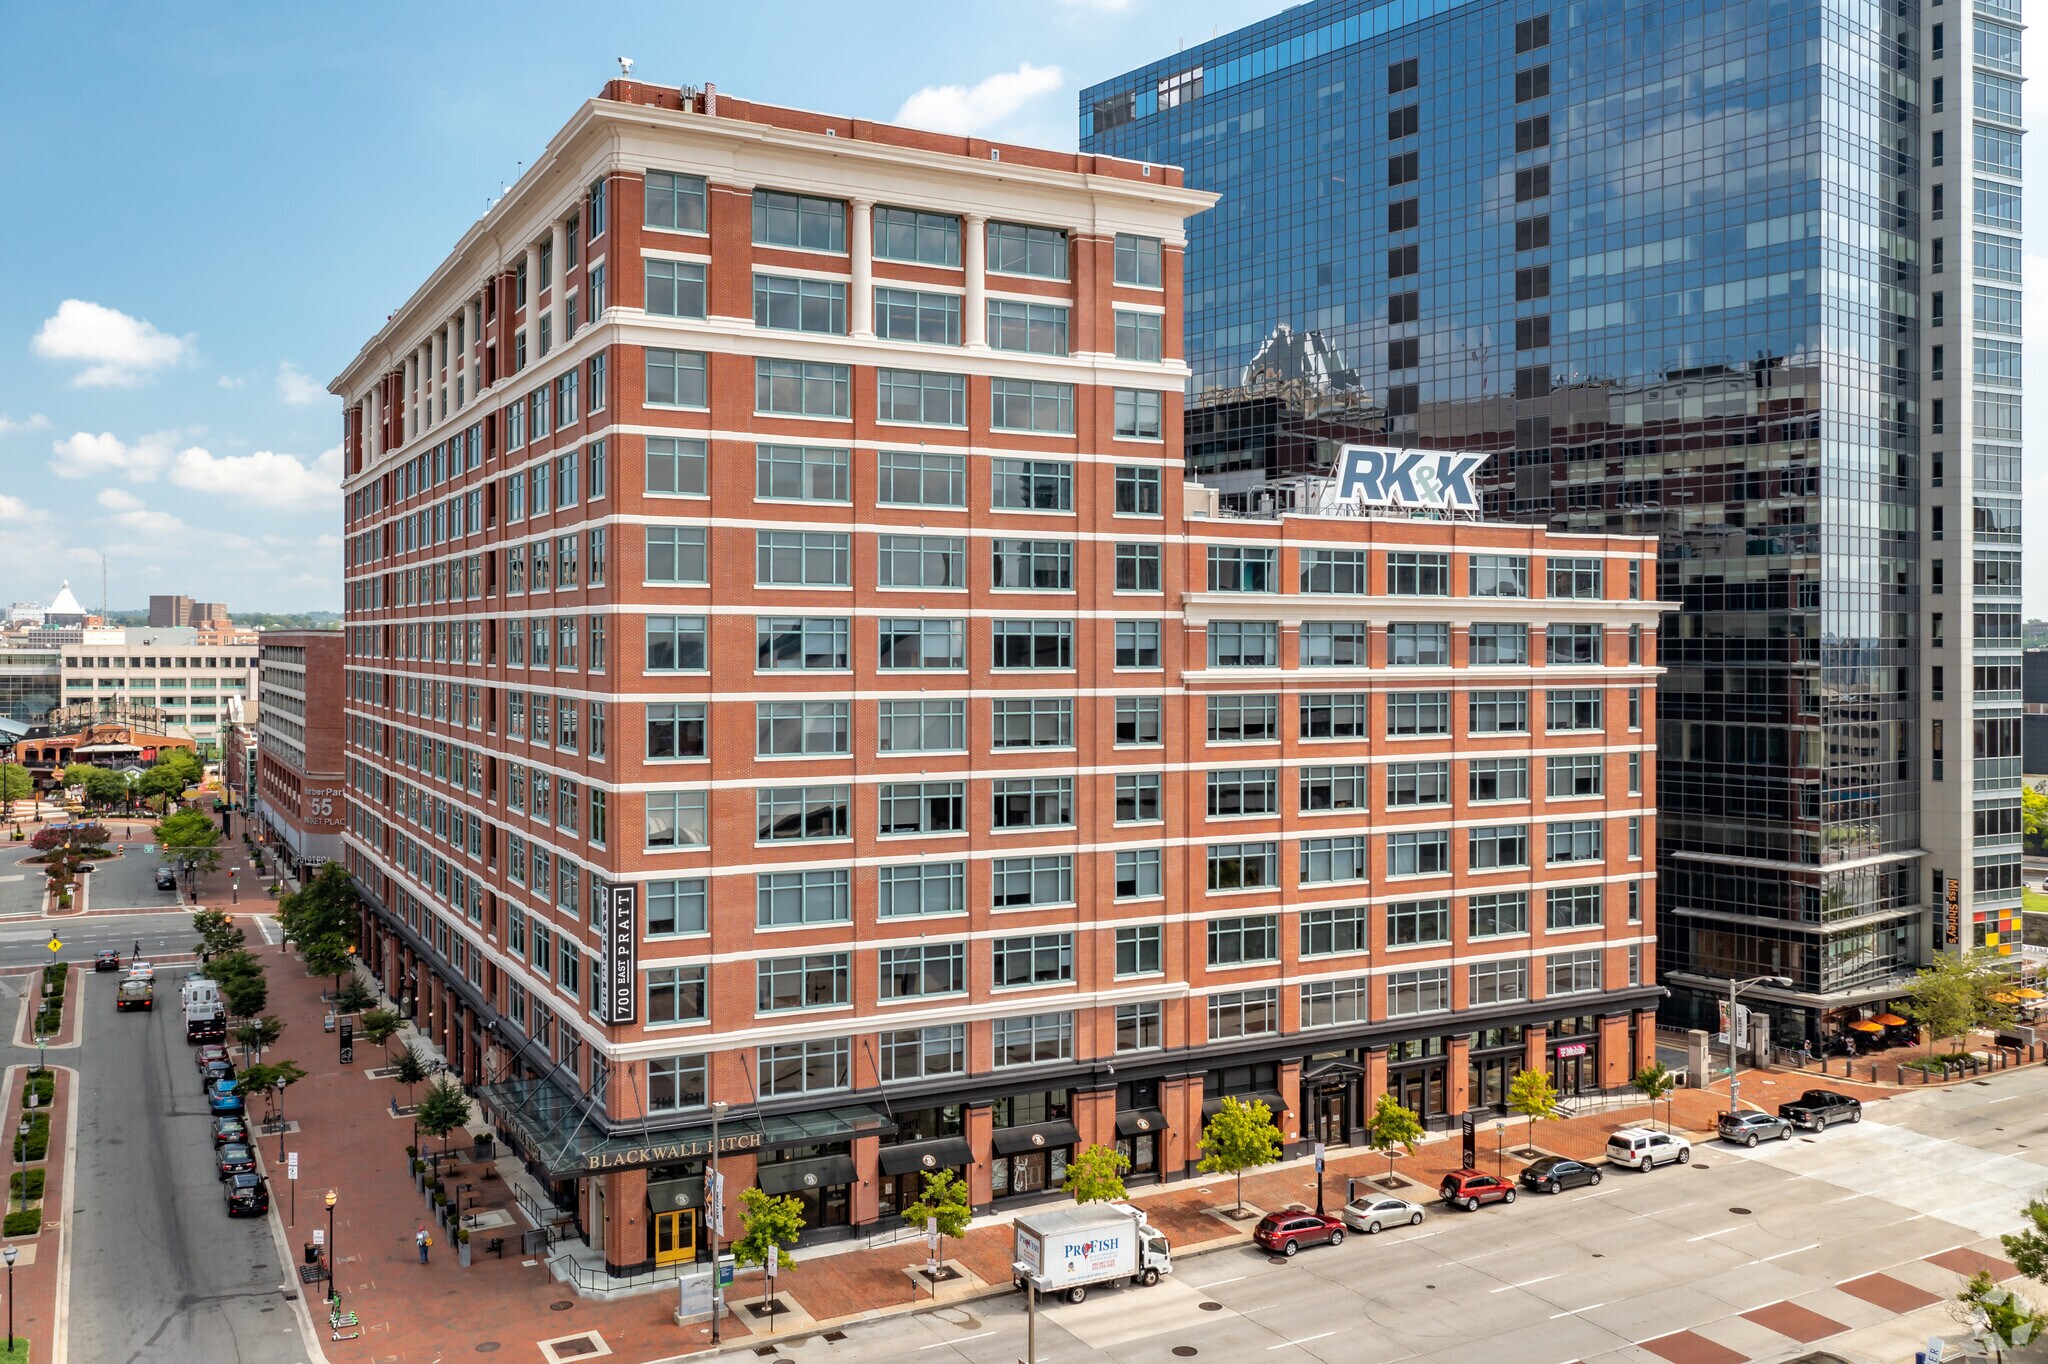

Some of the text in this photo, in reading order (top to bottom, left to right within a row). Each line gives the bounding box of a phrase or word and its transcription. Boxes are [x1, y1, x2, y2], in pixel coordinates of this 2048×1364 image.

[1341, 450, 1479, 504] RK&K
[311, 798, 333, 816] 55
[1947, 879, 1958, 944] Miss Shirley's
[618, 896, 629, 1014] 700 EAST PRATT
[589, 1142, 702, 1169] BLACKWALL
[1928, 1348, 1939, 1364] ER
